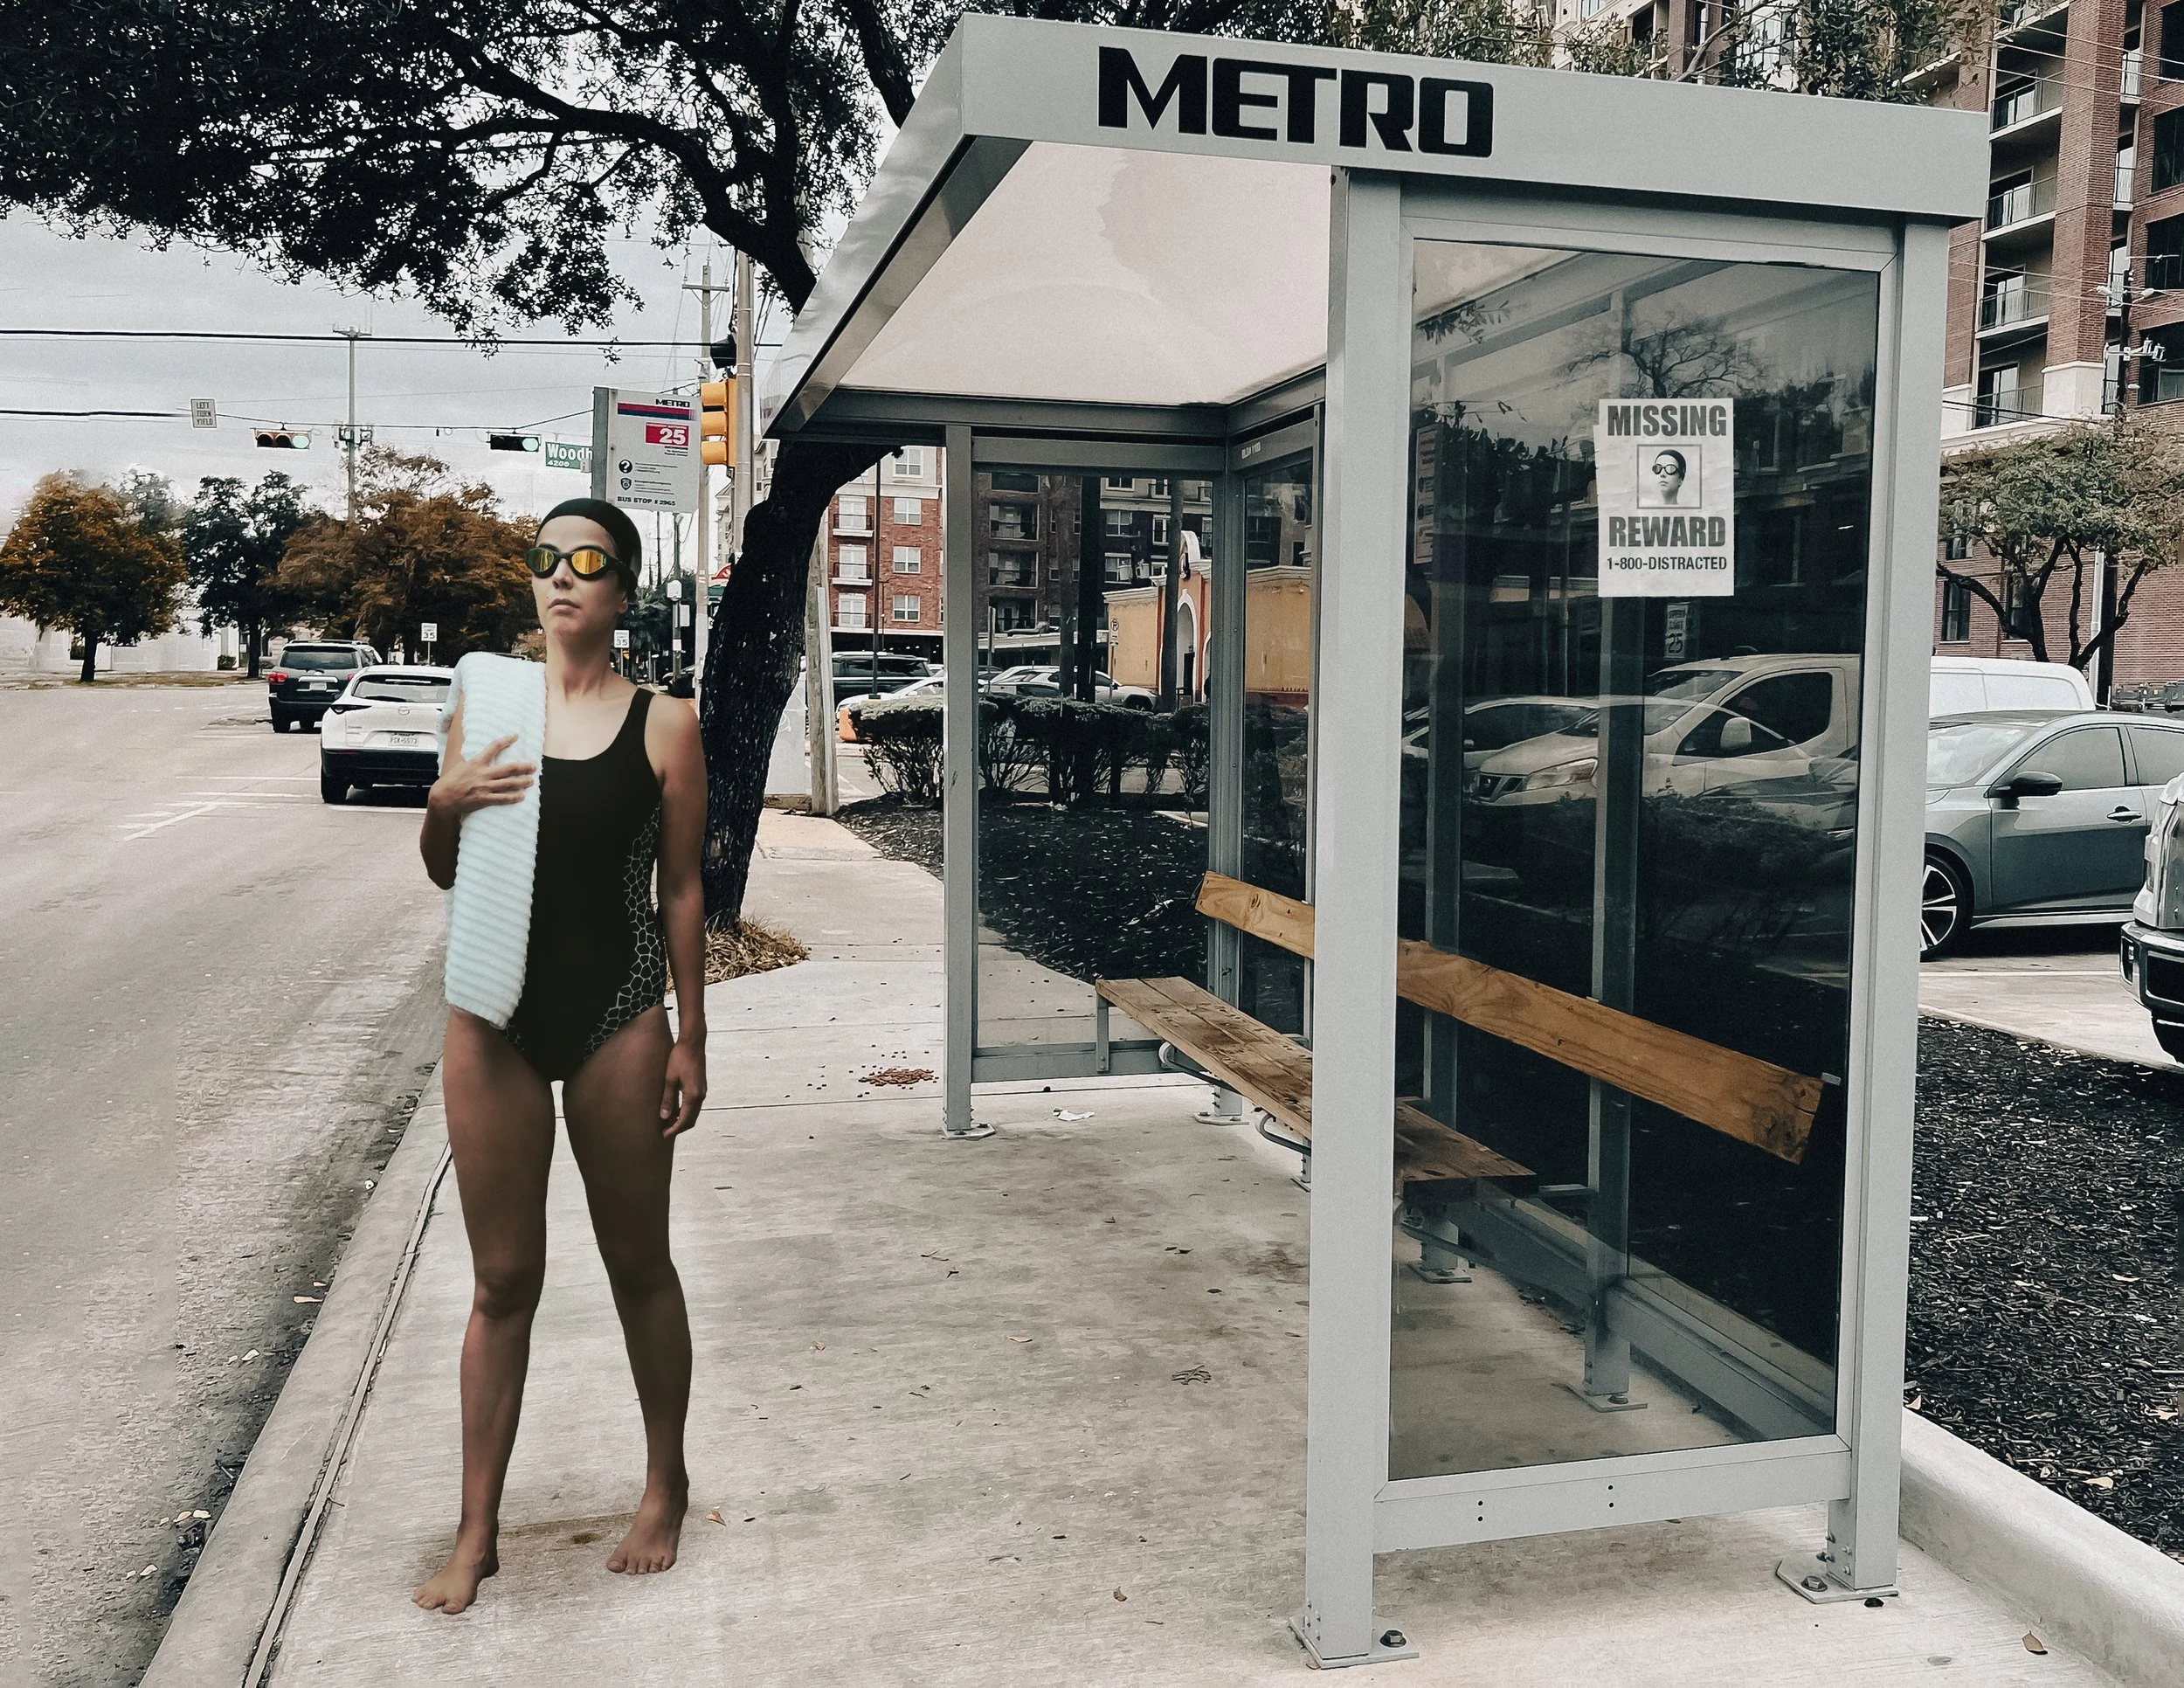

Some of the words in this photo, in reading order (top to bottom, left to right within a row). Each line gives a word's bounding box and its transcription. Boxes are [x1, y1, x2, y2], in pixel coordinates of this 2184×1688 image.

[1098, 46, 1494, 158] METRO
[655, 398, 690, 408] METRO
[1607, 405, 1727, 436] MISSING
[659, 428, 686, 445] 25
[1609, 516, 1725, 547] REWARD
[1607, 557, 1727, 570] 1-800-DISTRACTED
[1669, 633, 1683, 654] 25
